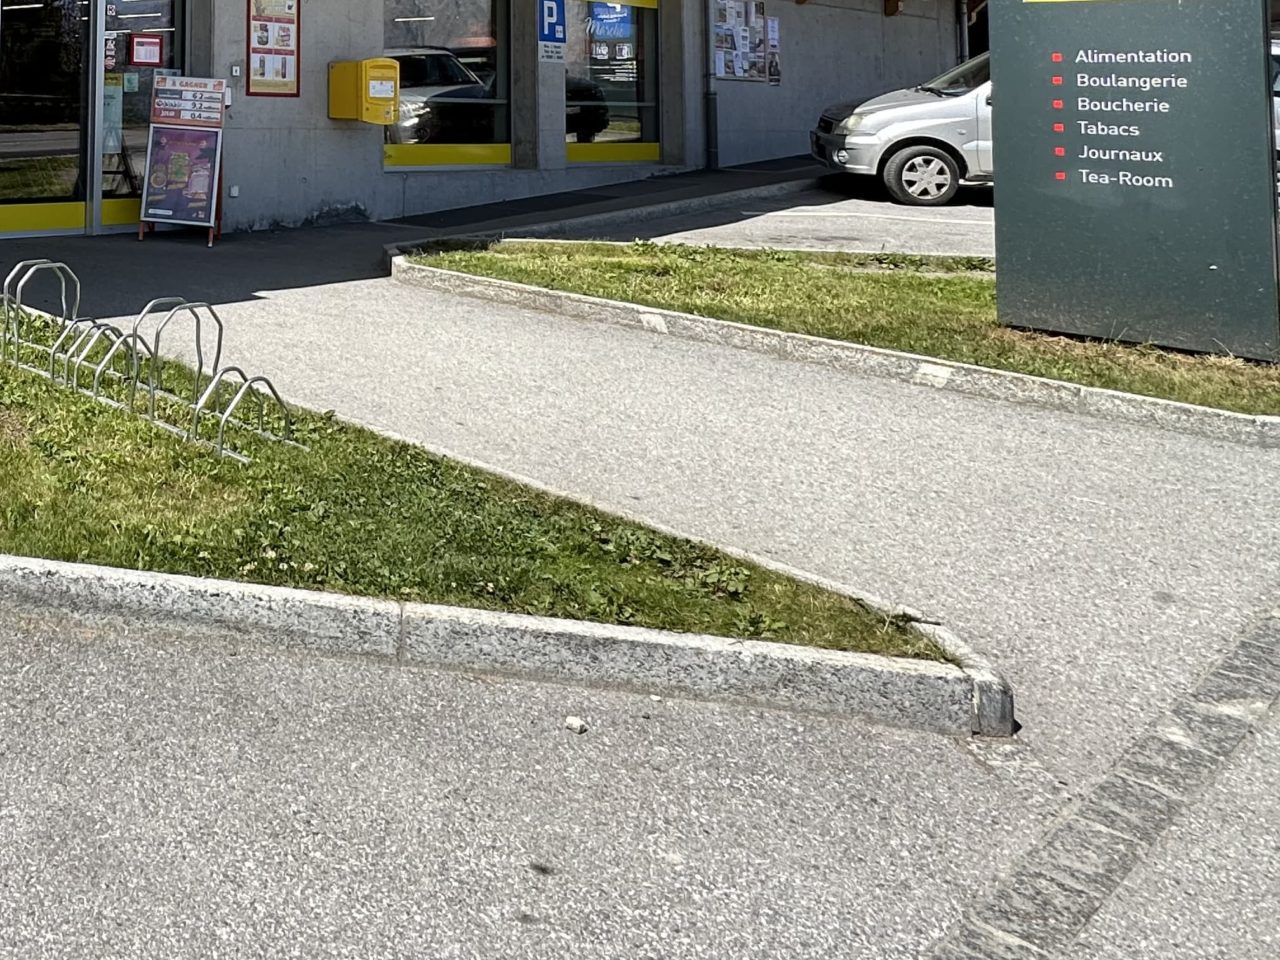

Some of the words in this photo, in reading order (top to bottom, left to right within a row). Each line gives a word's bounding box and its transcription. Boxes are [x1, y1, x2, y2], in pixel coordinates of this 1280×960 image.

[543, 0, 557, 35] P
[1075, 49, 1192, 63] Alimentation
[1076, 73, 1188, 91] Boulangerie
[1077, 97, 1170, 112] Boucherie
[1077, 120, 1140, 136] Tabacs
[1078, 145, 1163, 162] Journaux
[1078, 169, 1174, 187] Tea-Room
